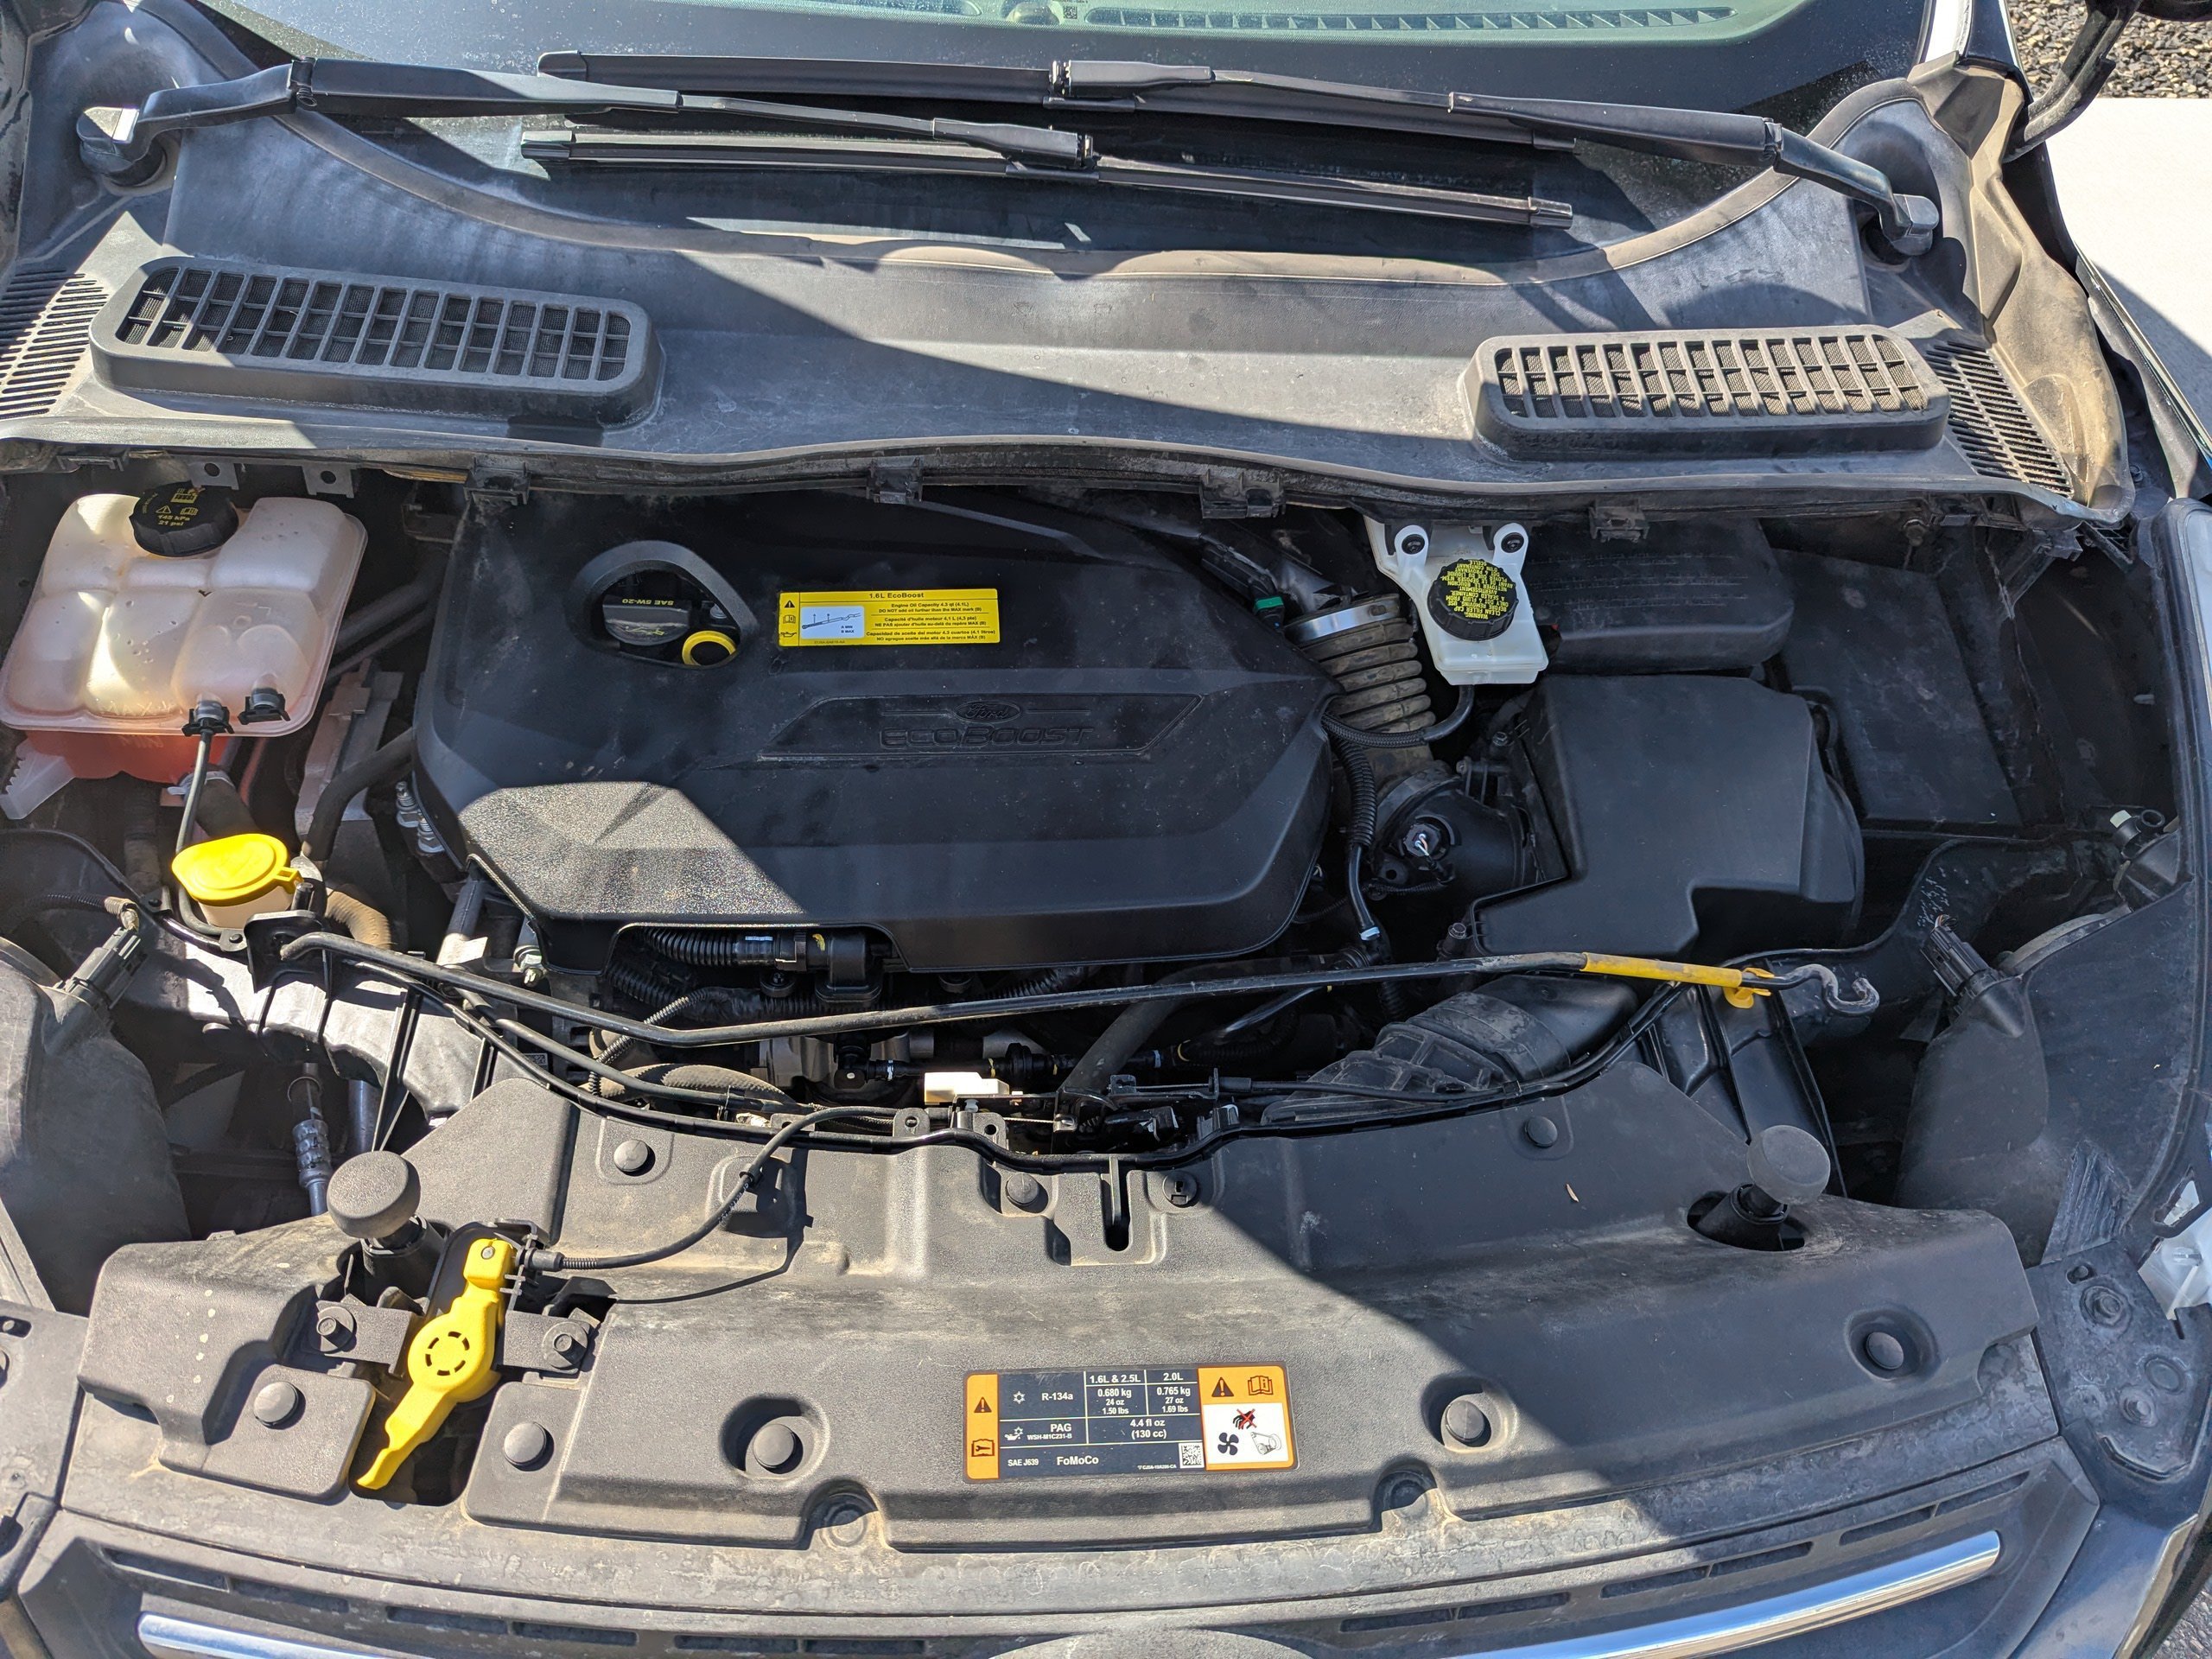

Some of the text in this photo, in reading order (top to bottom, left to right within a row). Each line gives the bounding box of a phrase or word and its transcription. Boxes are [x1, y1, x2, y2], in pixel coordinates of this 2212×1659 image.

[965, 703, 1009, 720] Ford
[1090, 1375, 1109, 1384] 1.6L
[1121, 1374, 1141, 1382] 2.5L
[1097, 1389, 1132, 1398] 0.680 kg
[1157, 1387, 1191, 1396] 0.765 kg
[1041, 1392, 1073, 1401] R-134a
[1051, 1423, 1071, 1432] PAG
[1130, 1419, 1144, 1427] 4.4
[1131, 1429, 1166, 1440] (130 cc)
[1057, 1456, 1098, 1465] FoMoCo
